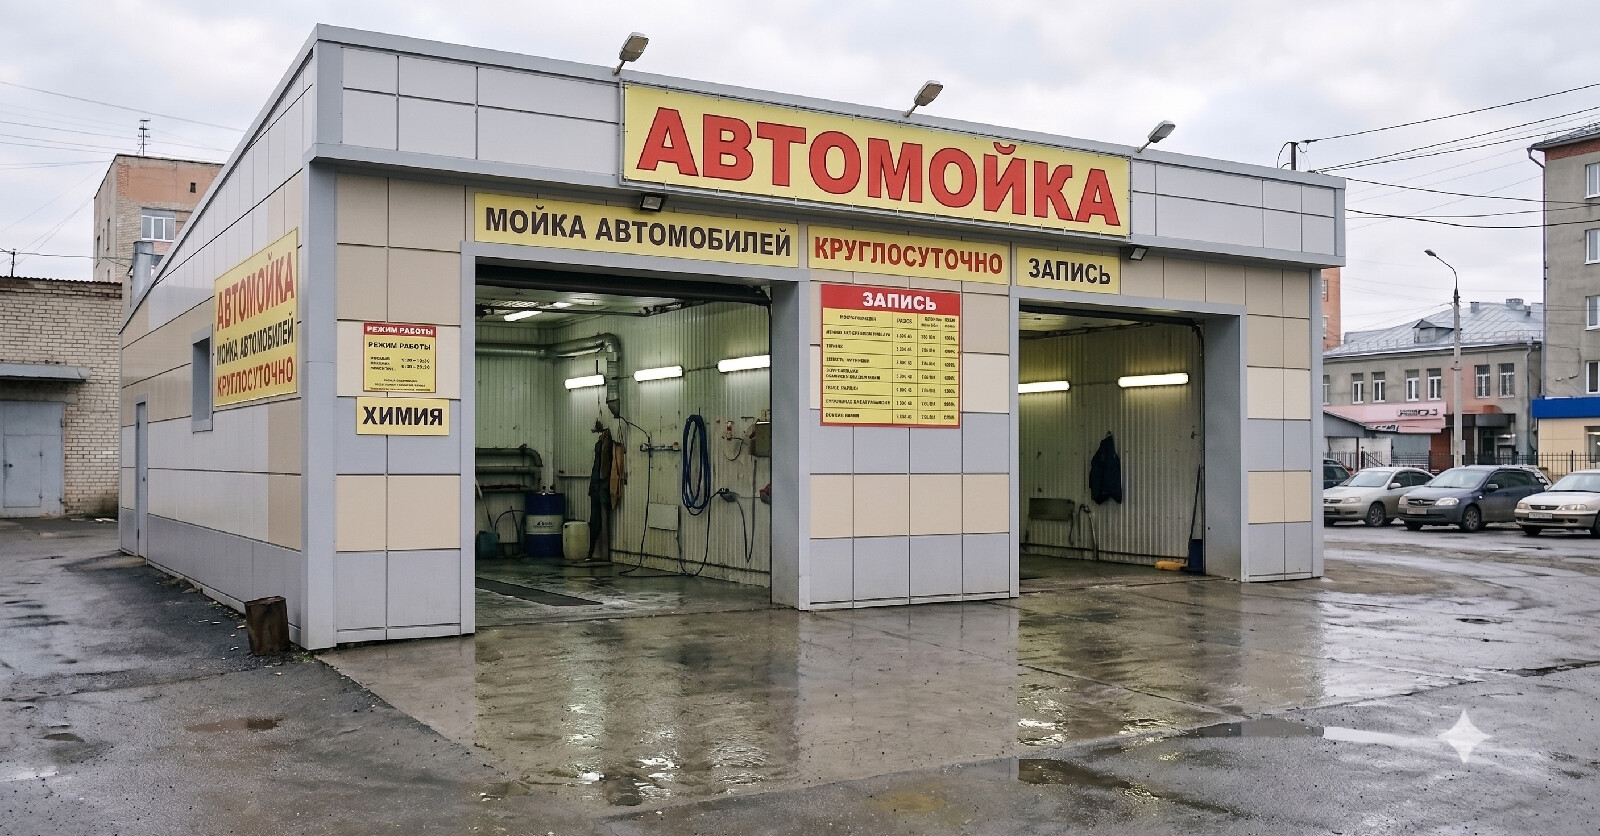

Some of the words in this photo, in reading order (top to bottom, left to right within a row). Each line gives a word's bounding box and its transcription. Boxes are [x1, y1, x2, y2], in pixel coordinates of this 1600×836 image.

[636, 107, 1121, 226] АВТОМОЙКА
[485, 205, 587, 239] МОЙКА
[595, 217, 791, 257] АВТОМОБИЛЕЙ
[814, 236, 1003, 275] КРУГЛОСУТОЧНО
[1028, 257, 1111, 285] ЗАПИСЬ
[217, 251, 295, 332] АВТОМОЙКА
[862, 291, 937, 311] ЗАПИСЬ
[216, 337, 239, 366] МОЙКА
[239, 311, 294, 360] АВТОМОБИЛЕЙ
[368, 341, 397, 349] РЕЖИМ
[399, 342, 431, 350] РАБОТЫ
[399, 327, 433, 335] РАБОТЫ
[217, 356, 294, 397] КРУГЛОСУТОЧНО
[362, 405, 443, 426] ХИМИЯ
